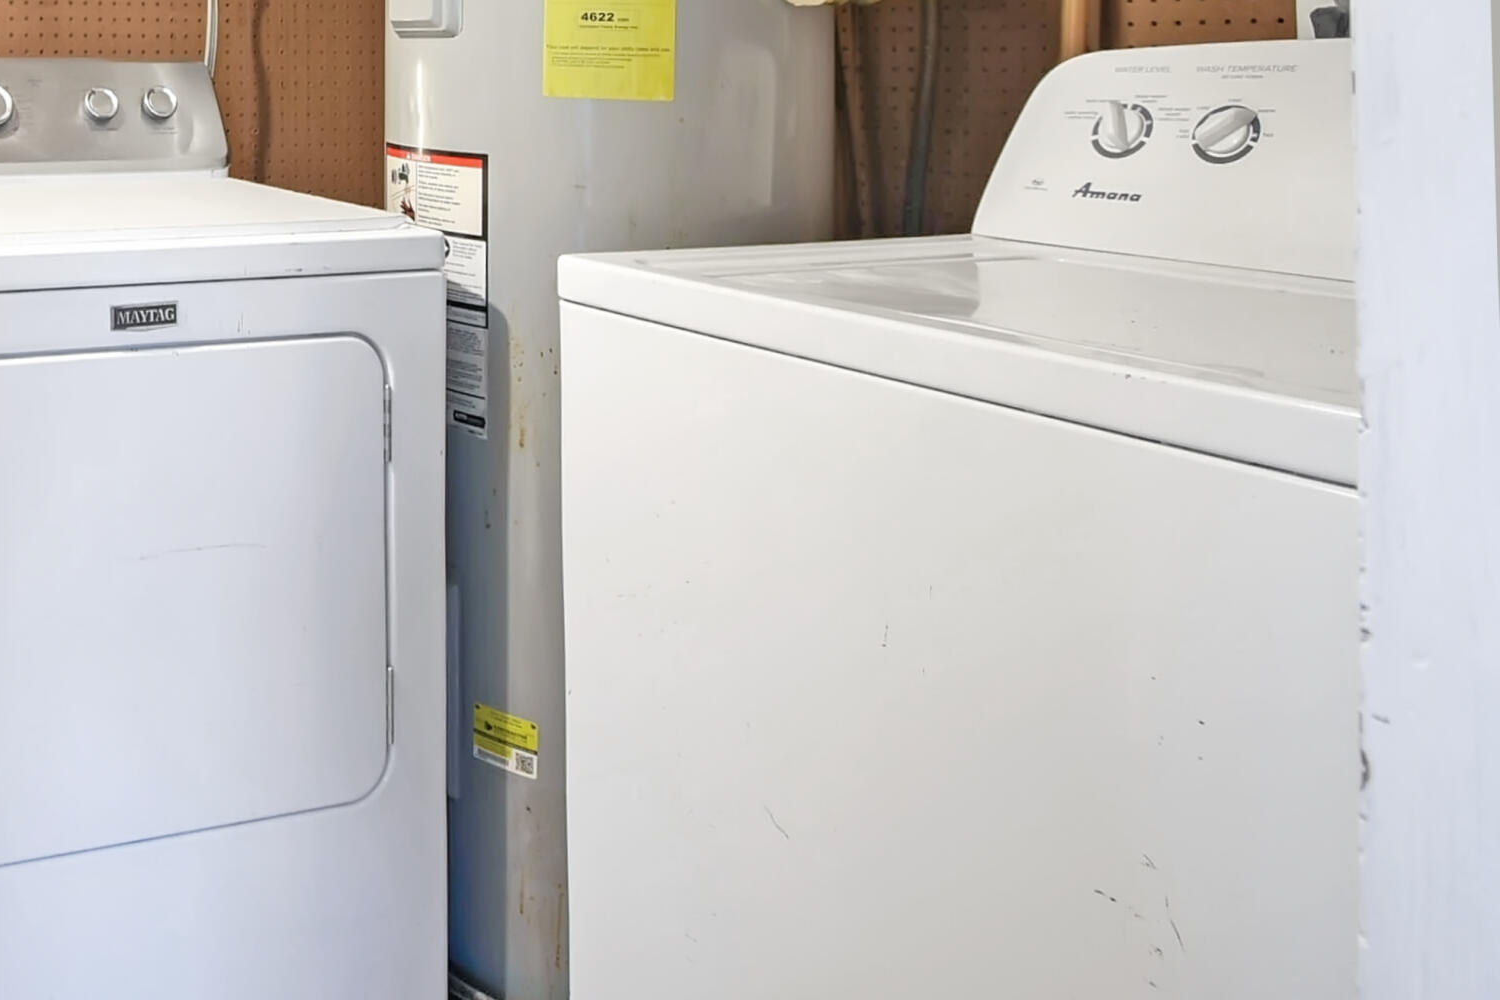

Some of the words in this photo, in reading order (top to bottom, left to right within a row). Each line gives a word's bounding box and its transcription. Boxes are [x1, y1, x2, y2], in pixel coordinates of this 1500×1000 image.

[581, 12, 615, 23] 4622
[1227, 64, 1298, 73] TEMPERATURE
[1072, 182, 1143, 202] Amana
[117, 307, 176, 325] MAYTAG
